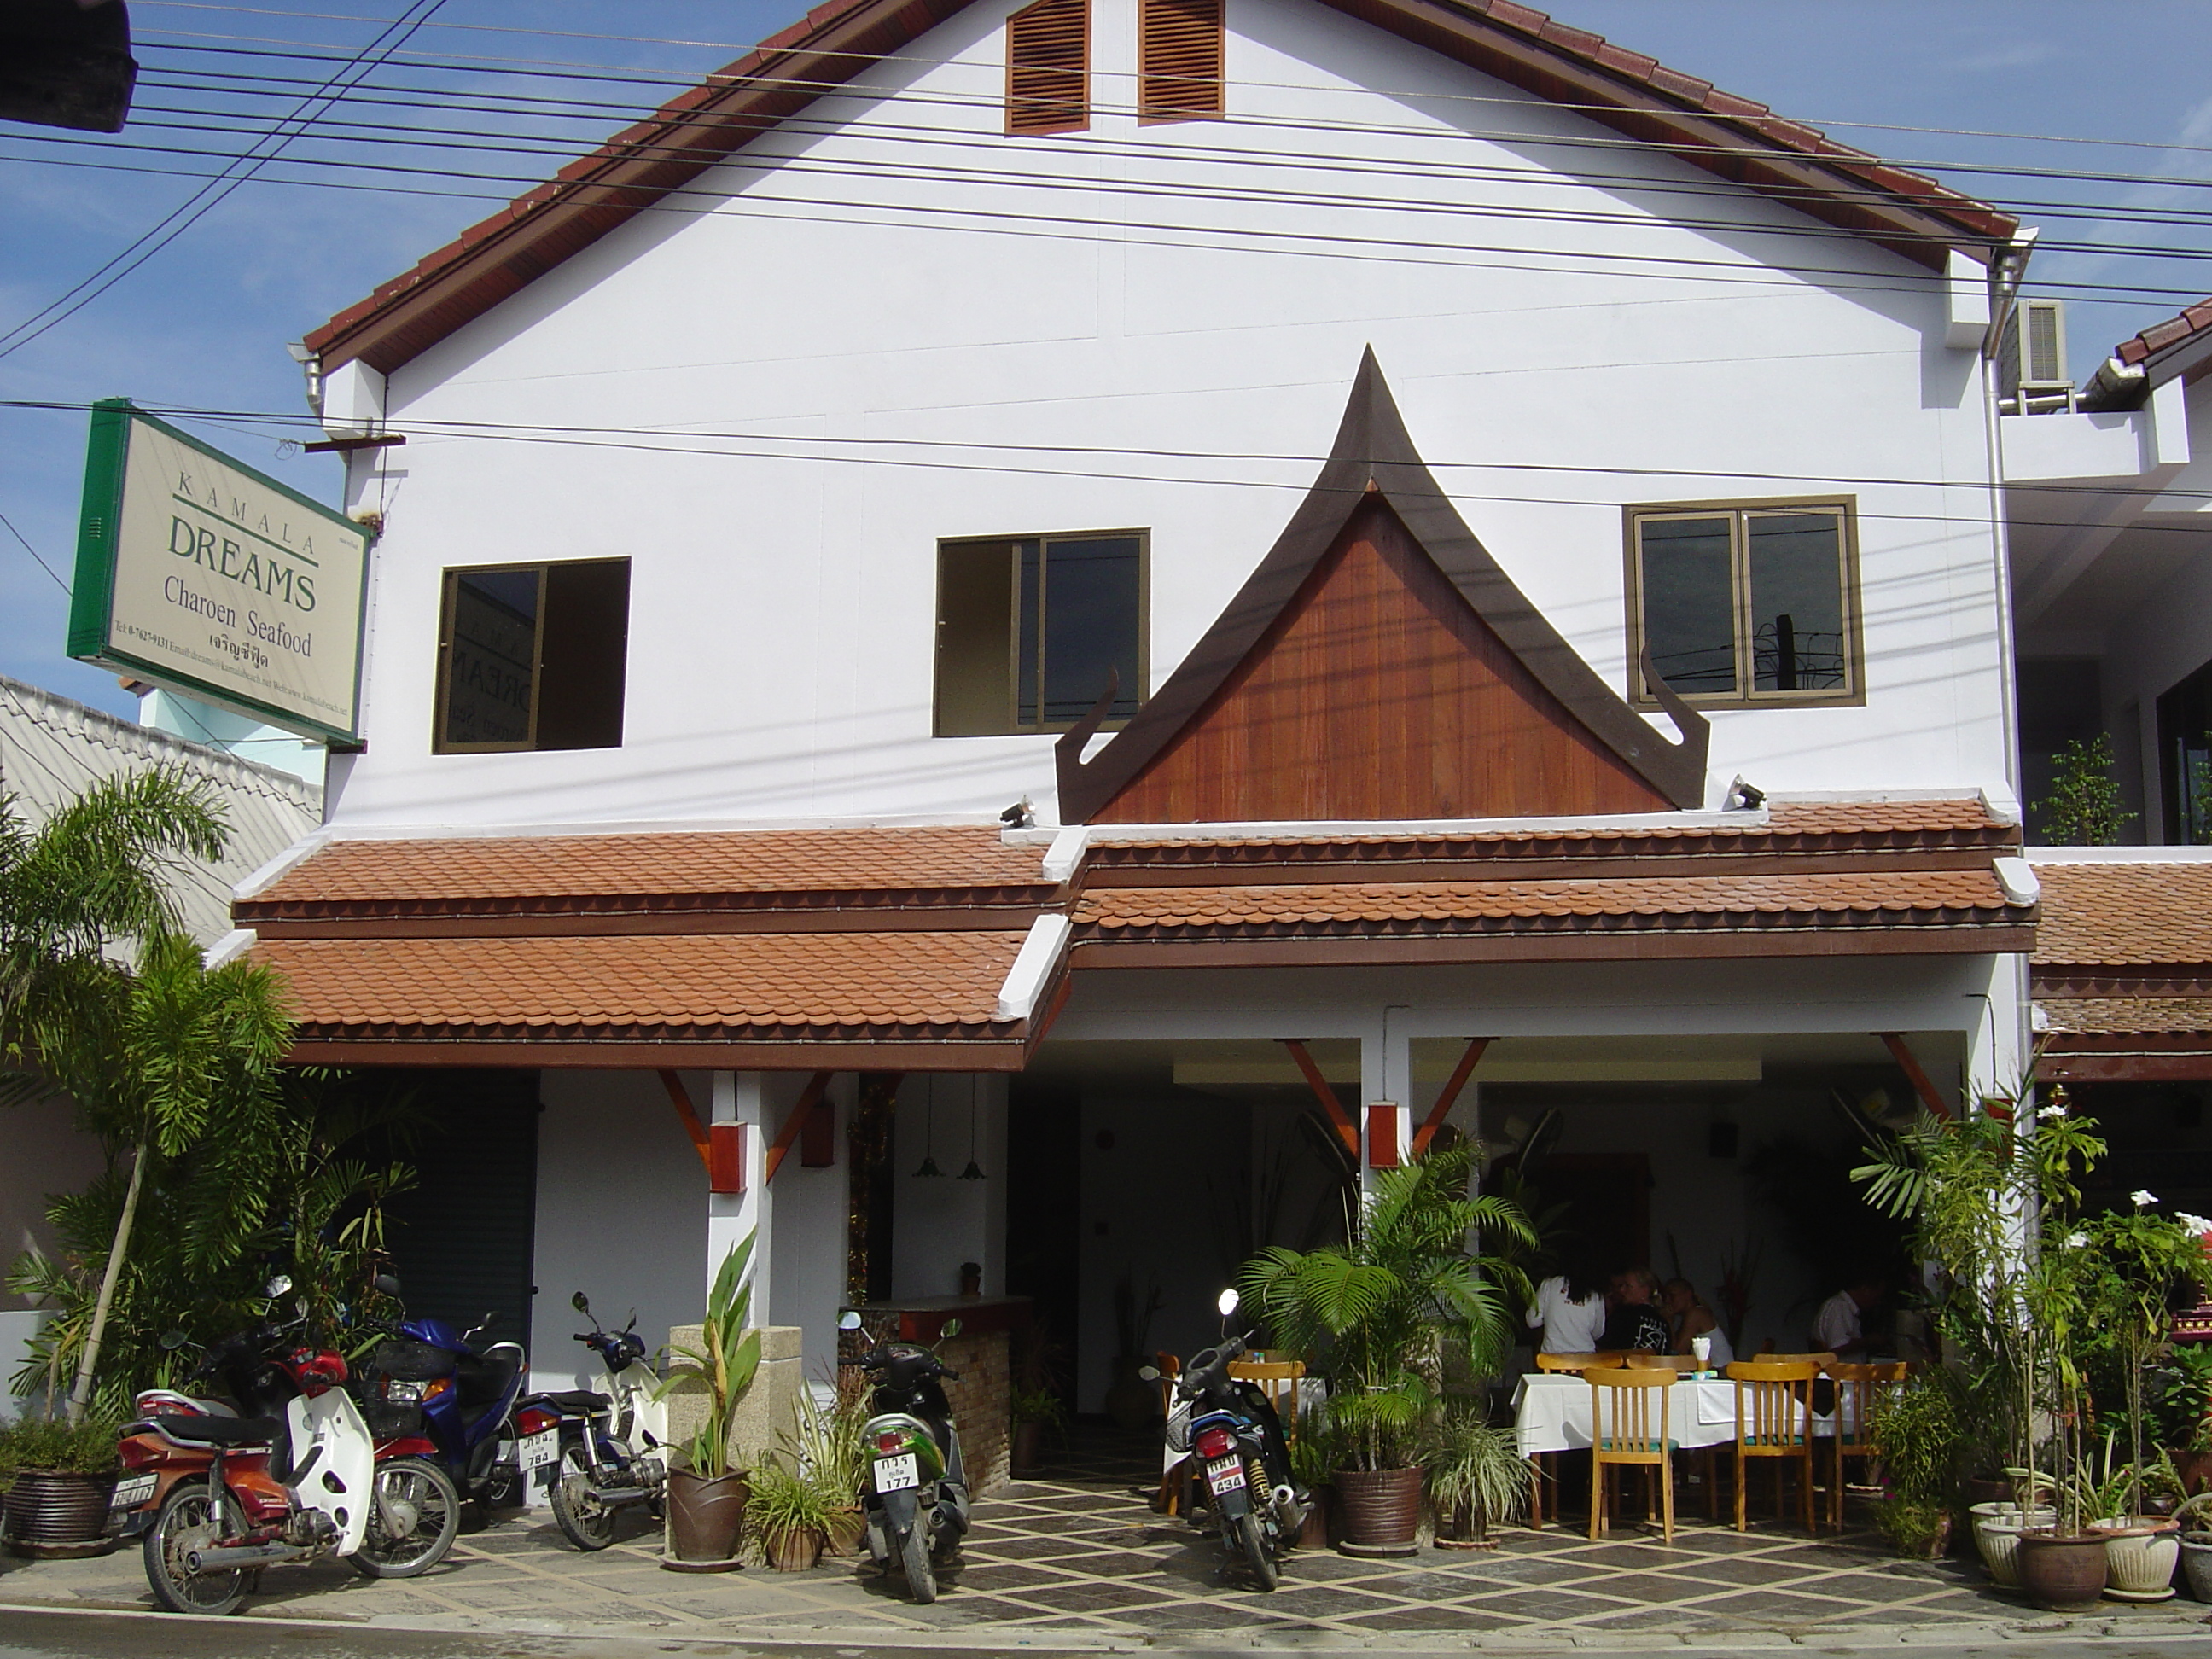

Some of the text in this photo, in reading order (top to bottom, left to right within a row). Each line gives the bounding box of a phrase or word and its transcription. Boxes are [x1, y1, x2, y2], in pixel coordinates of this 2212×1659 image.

[179, 471, 314, 555] KAMALA
[167, 514, 316, 612] DREAMS
[164, 575, 312, 657] Charoen Seafood
[528, 1452, 548, 1466] 784
[887, 1476, 911, 1490] 177
[1217, 1476, 1242, 1493] 434
